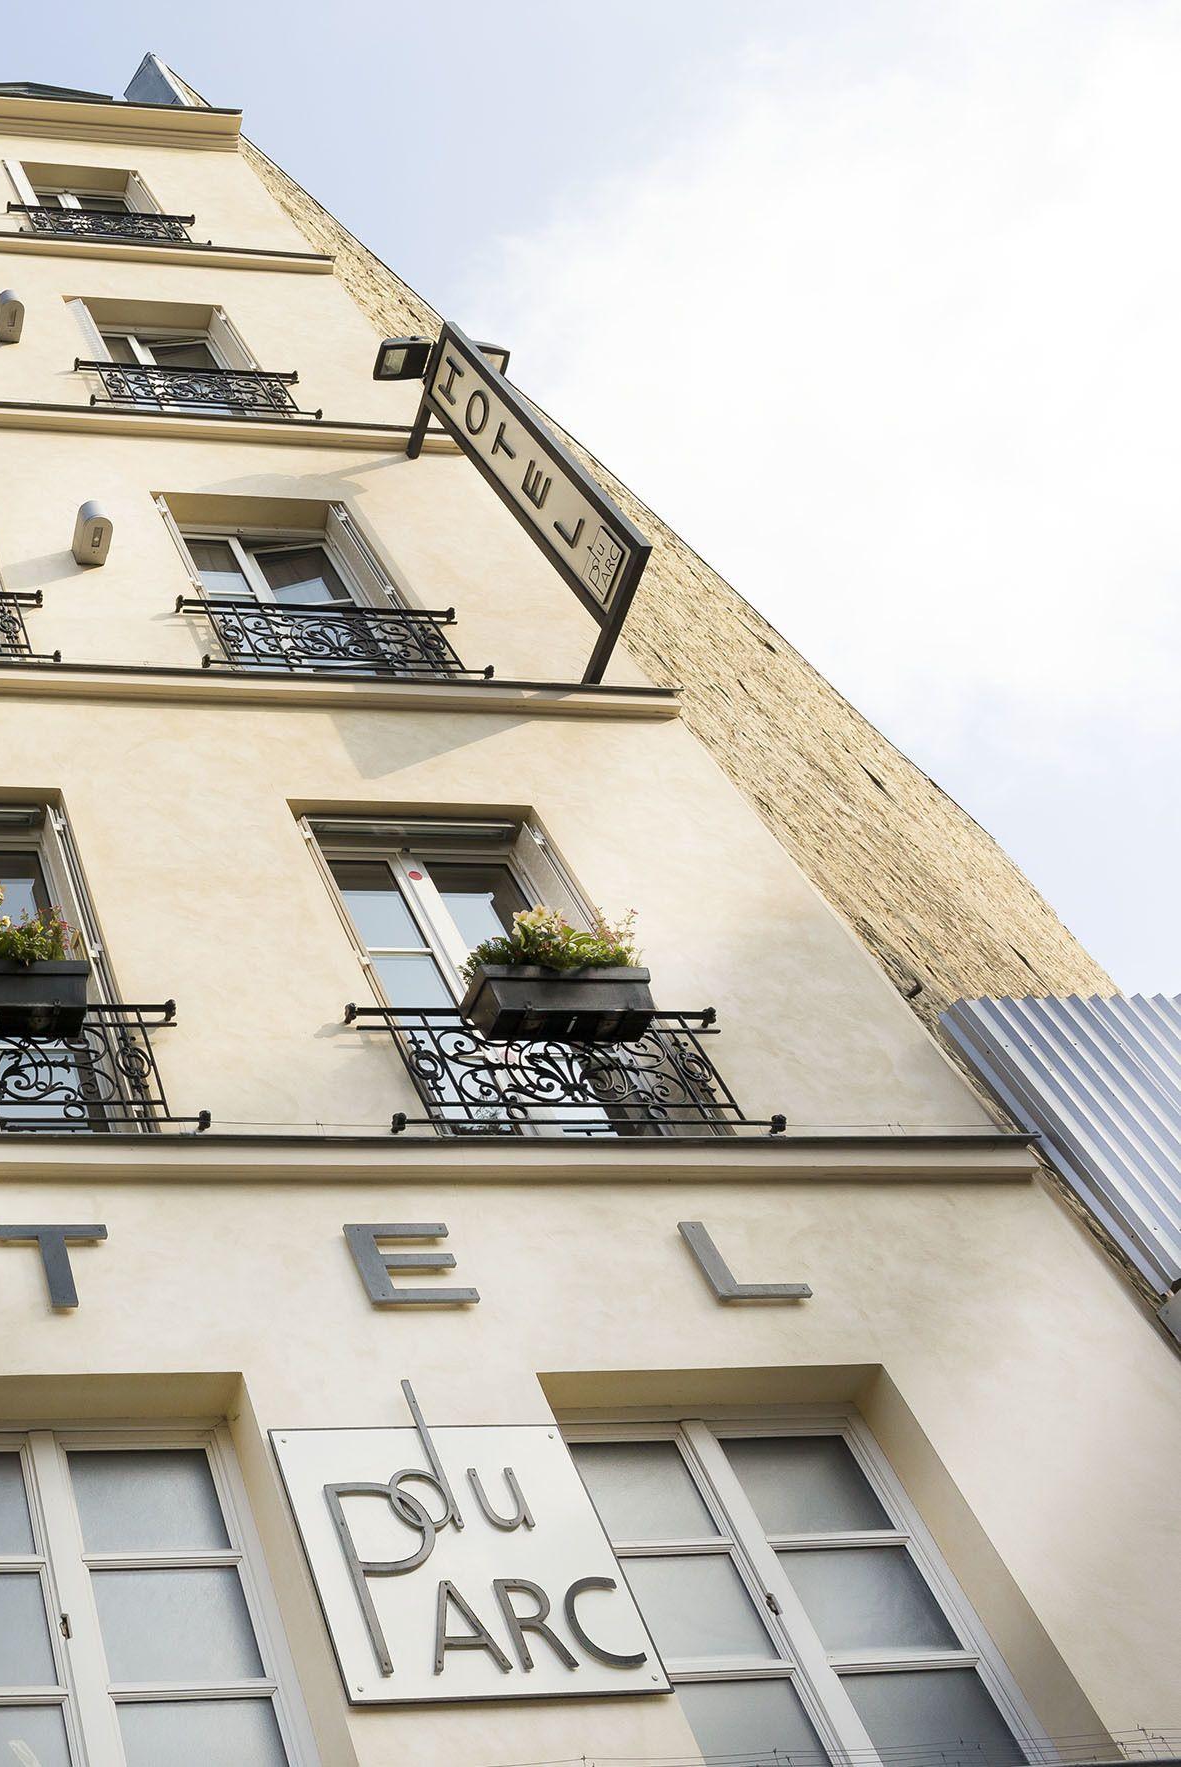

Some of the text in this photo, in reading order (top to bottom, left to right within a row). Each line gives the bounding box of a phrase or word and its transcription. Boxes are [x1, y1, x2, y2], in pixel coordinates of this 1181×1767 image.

[437, 355, 585, 550] HOTEL
[588, 544, 621, 597] PARC
[388, 1379, 536, 1531] du
[323, 1481, 648, 1677] PARC
